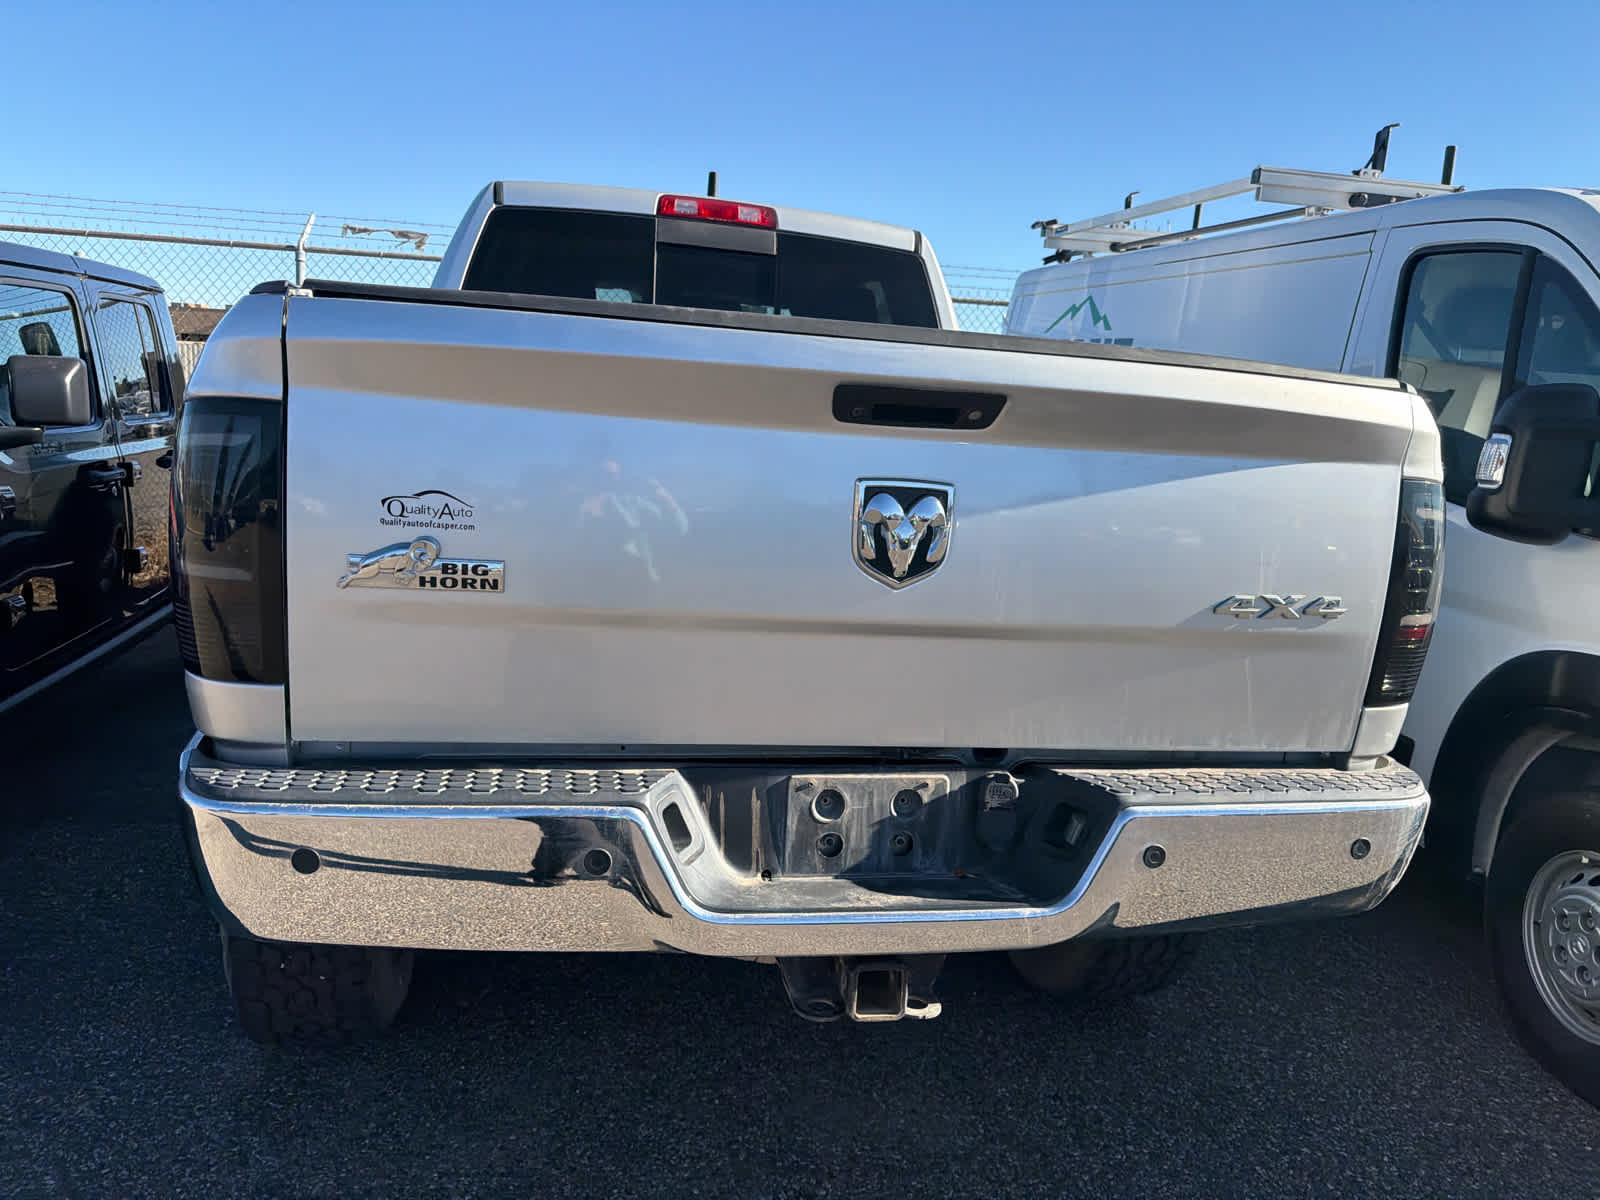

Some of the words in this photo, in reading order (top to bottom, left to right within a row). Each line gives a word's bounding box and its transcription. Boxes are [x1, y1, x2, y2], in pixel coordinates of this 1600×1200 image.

[379, 517, 475, 531] qualityautoofcasper.com
[441, 563, 489, 576] BIG
[419, 575, 499, 590] HORN
